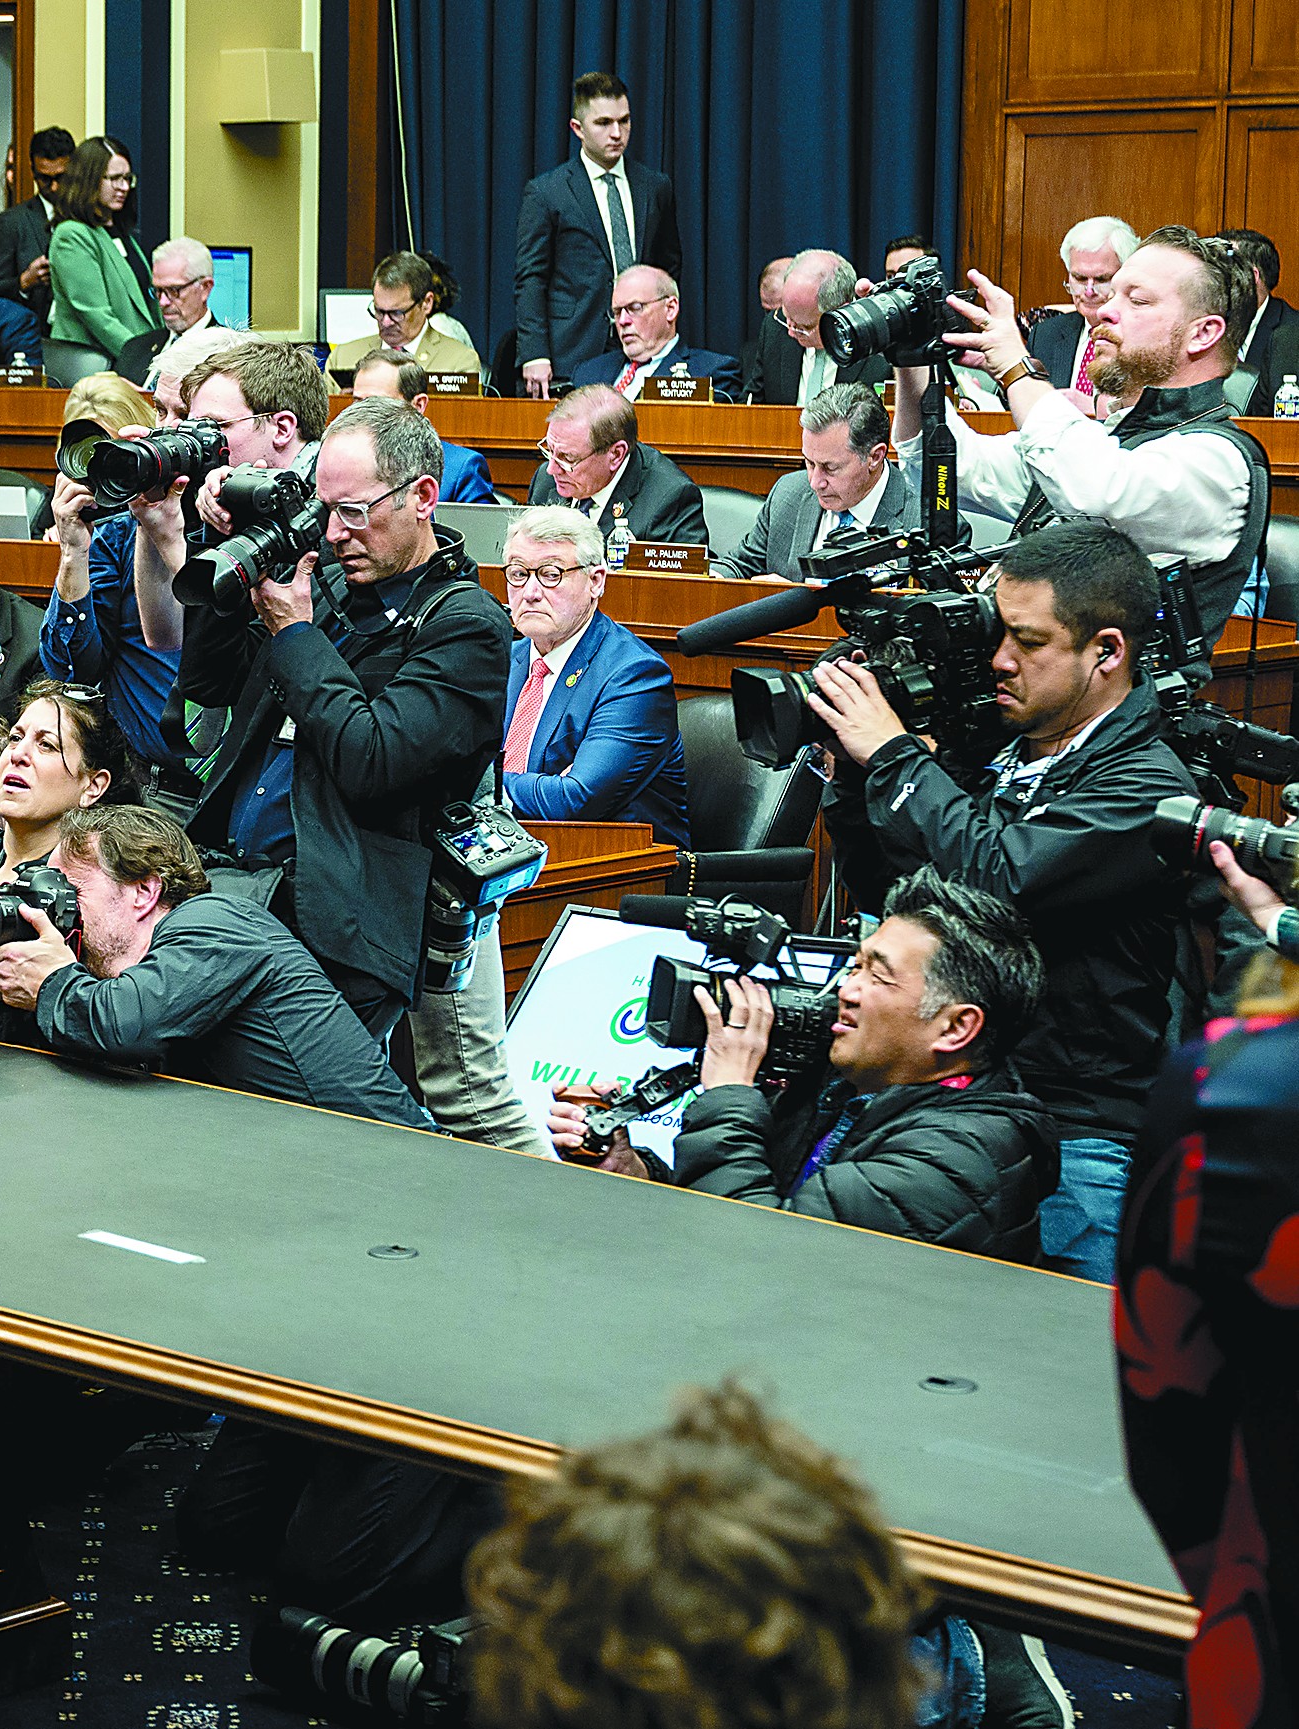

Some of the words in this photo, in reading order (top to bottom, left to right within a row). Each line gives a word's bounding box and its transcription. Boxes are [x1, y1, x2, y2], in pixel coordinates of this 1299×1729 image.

[428, 375, 439, 384] MR.
[441, 375, 468, 384] GRIFFITH
[435, 384, 460, 392] VIRGINIA
[656, 380, 668, 389] MR.
[670, 380, 697, 390] GUTHRIE
[660, 388, 693, 398] KENTUCKY
[937, 464, 948, 496] Nikon
[936, 496, 950, 511] Z
[644, 548, 659, 558] MR.
[659, 550, 689, 560] PALMER
[648, 559, 683, 570] ALABAMA
